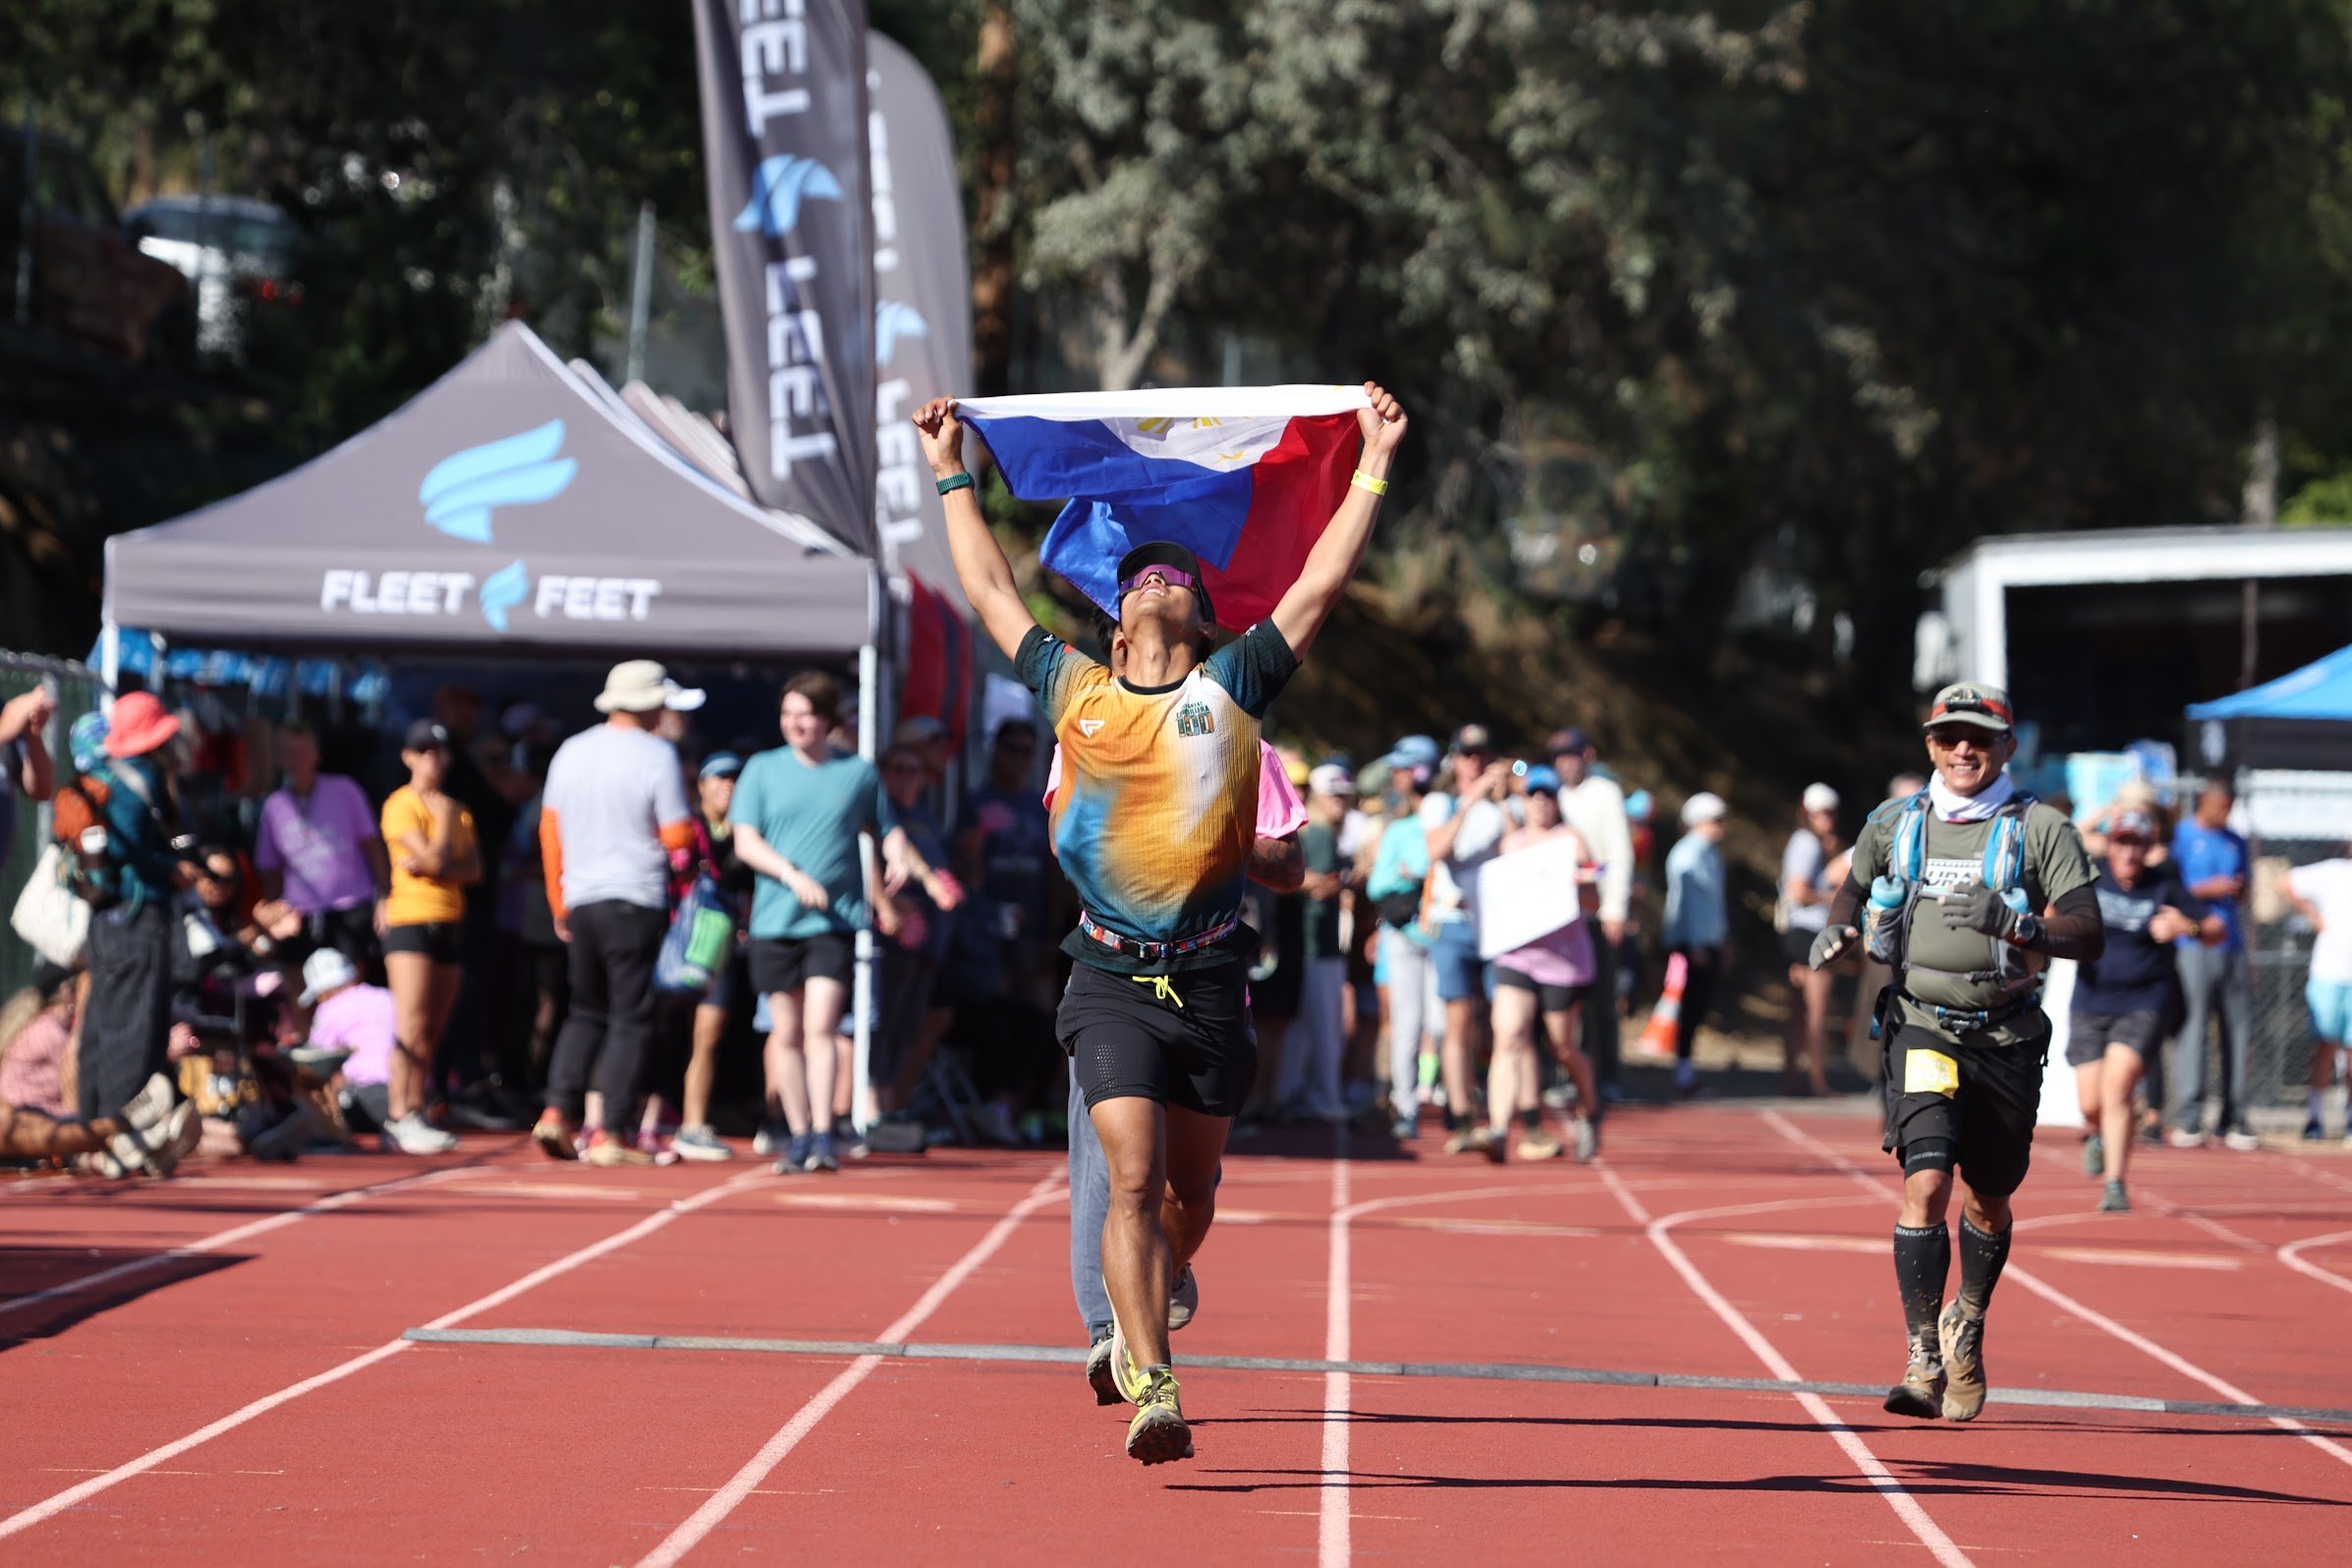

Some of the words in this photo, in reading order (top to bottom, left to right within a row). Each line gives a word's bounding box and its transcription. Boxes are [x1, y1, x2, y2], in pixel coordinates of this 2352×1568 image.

[320, 569, 476, 616] FLEET
[533, 575, 662, 621] FEET
[1176, 712, 1215, 738] 100
